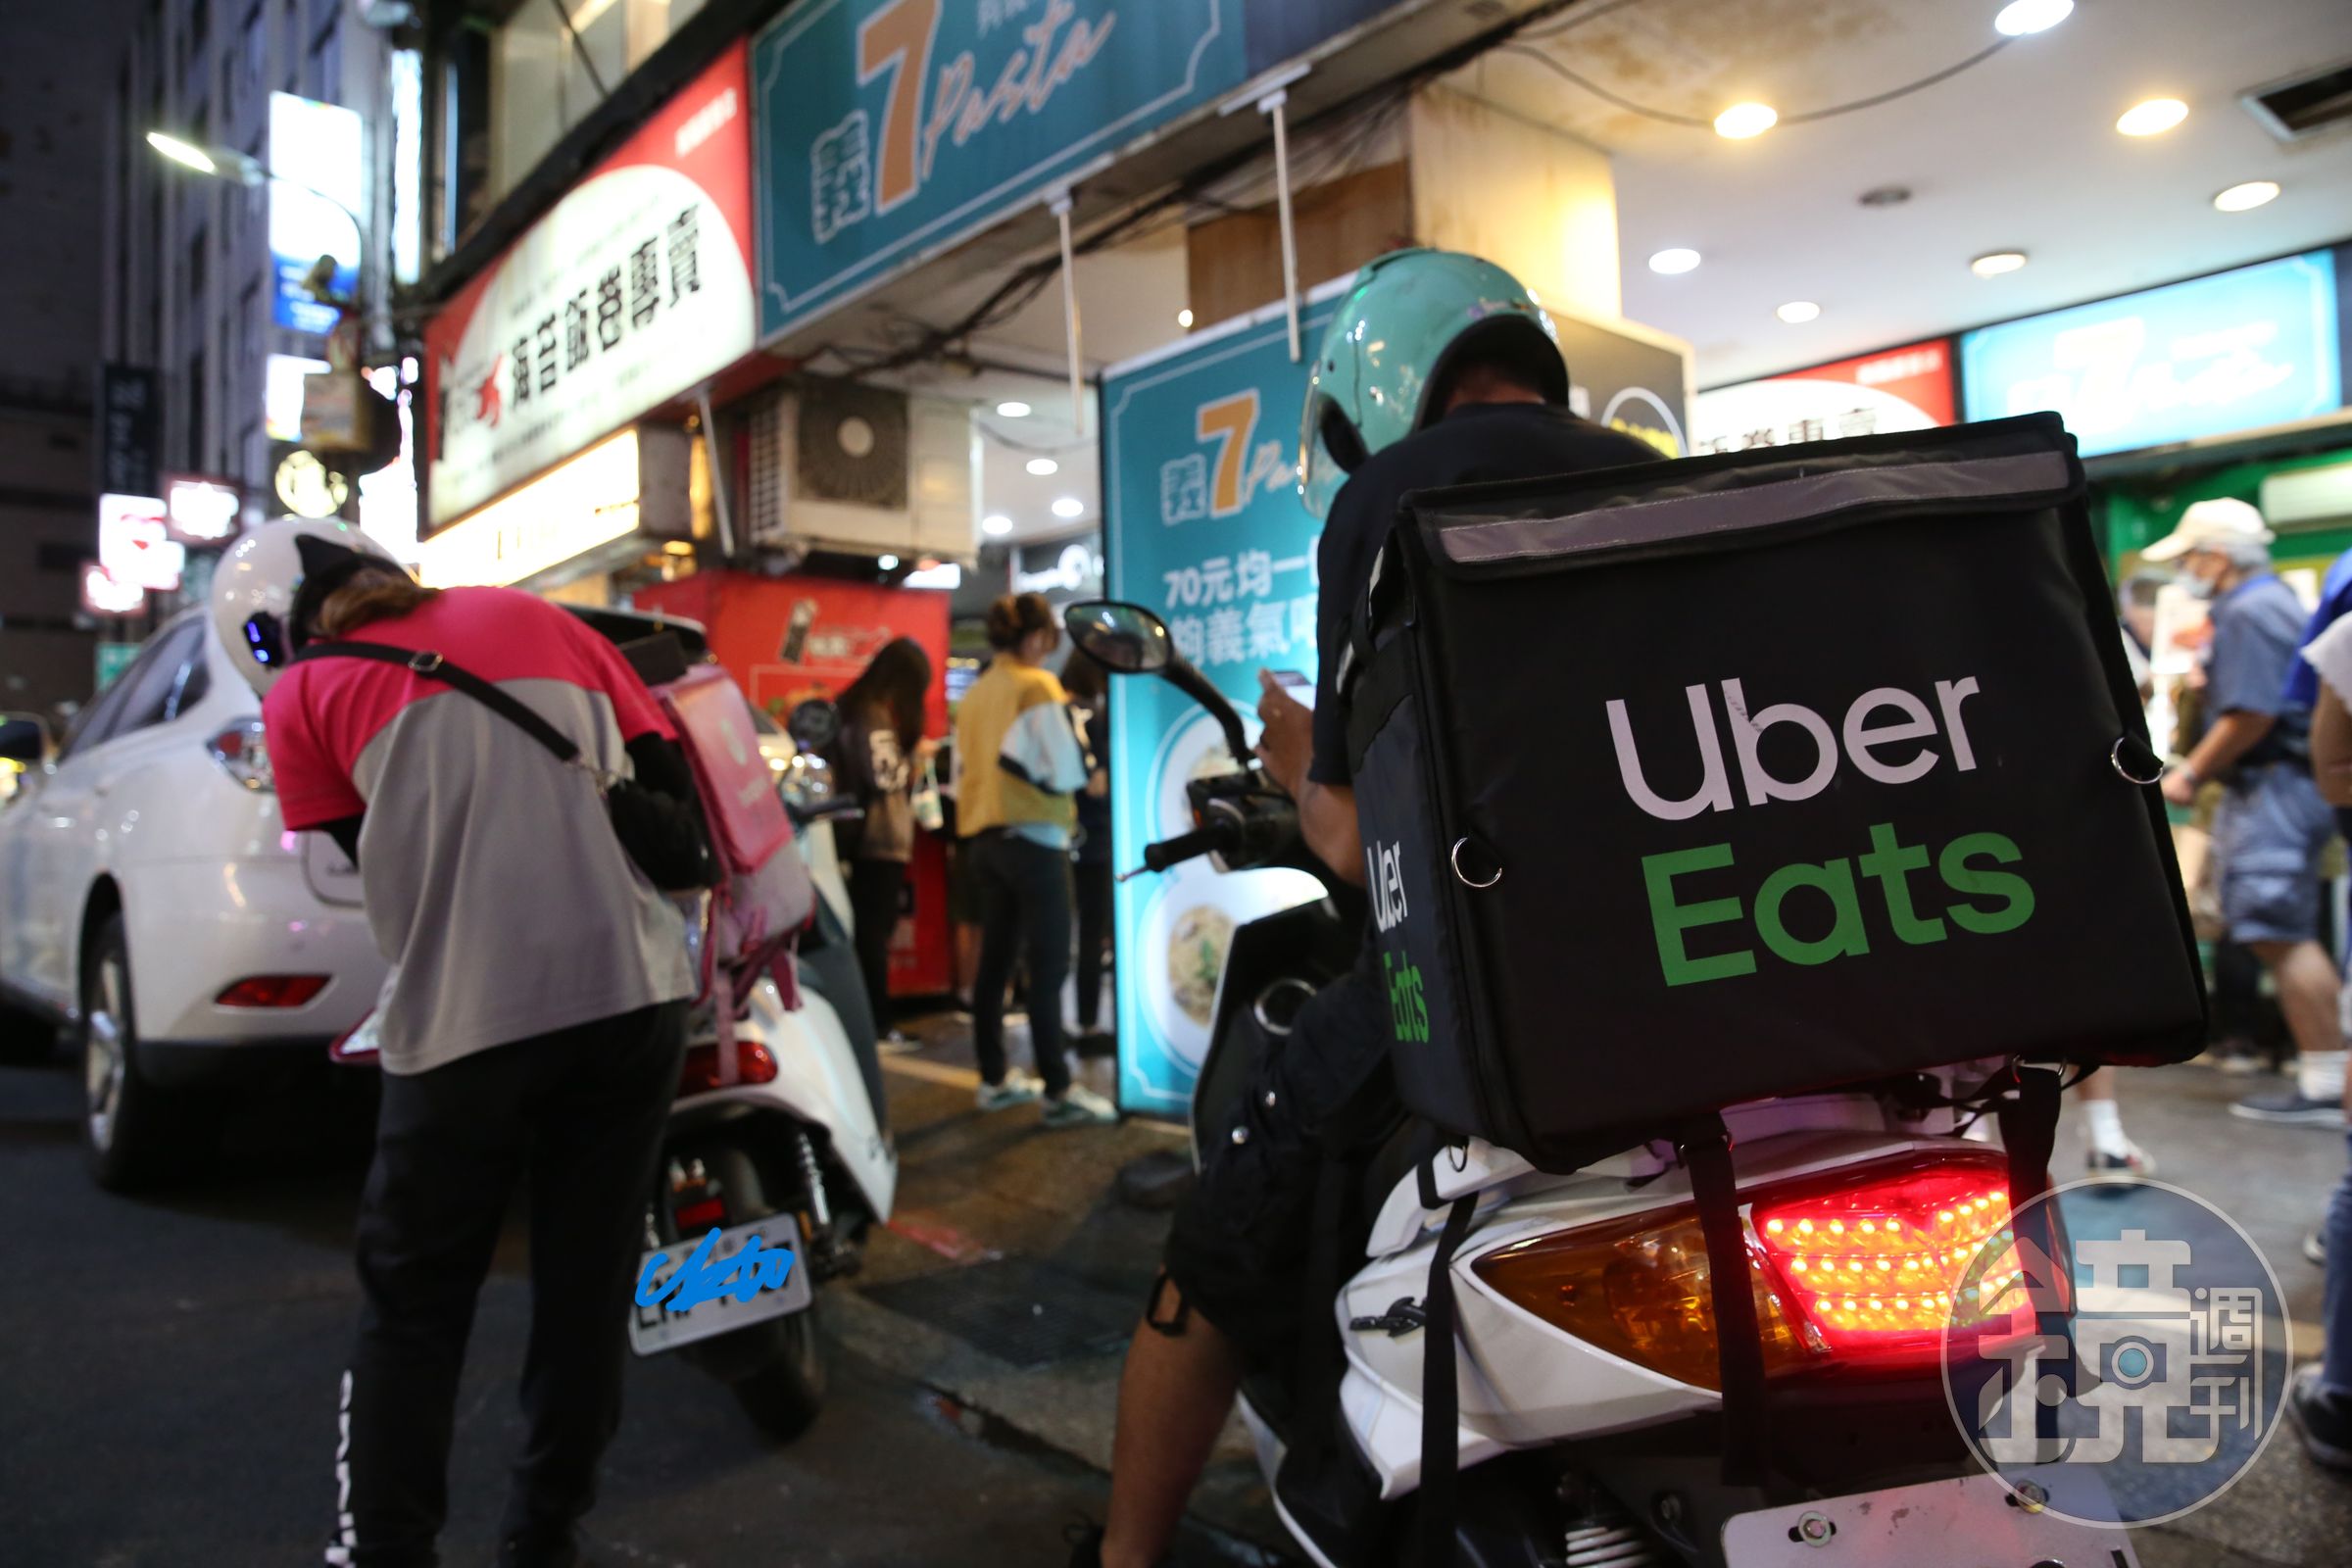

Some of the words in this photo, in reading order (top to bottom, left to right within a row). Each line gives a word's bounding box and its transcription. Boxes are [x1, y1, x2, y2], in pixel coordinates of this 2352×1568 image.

[920, 0, 1116, 181] Pasta
[1605, 675, 1980, 820] Uber
[1642, 822, 2035, 987] Eats
